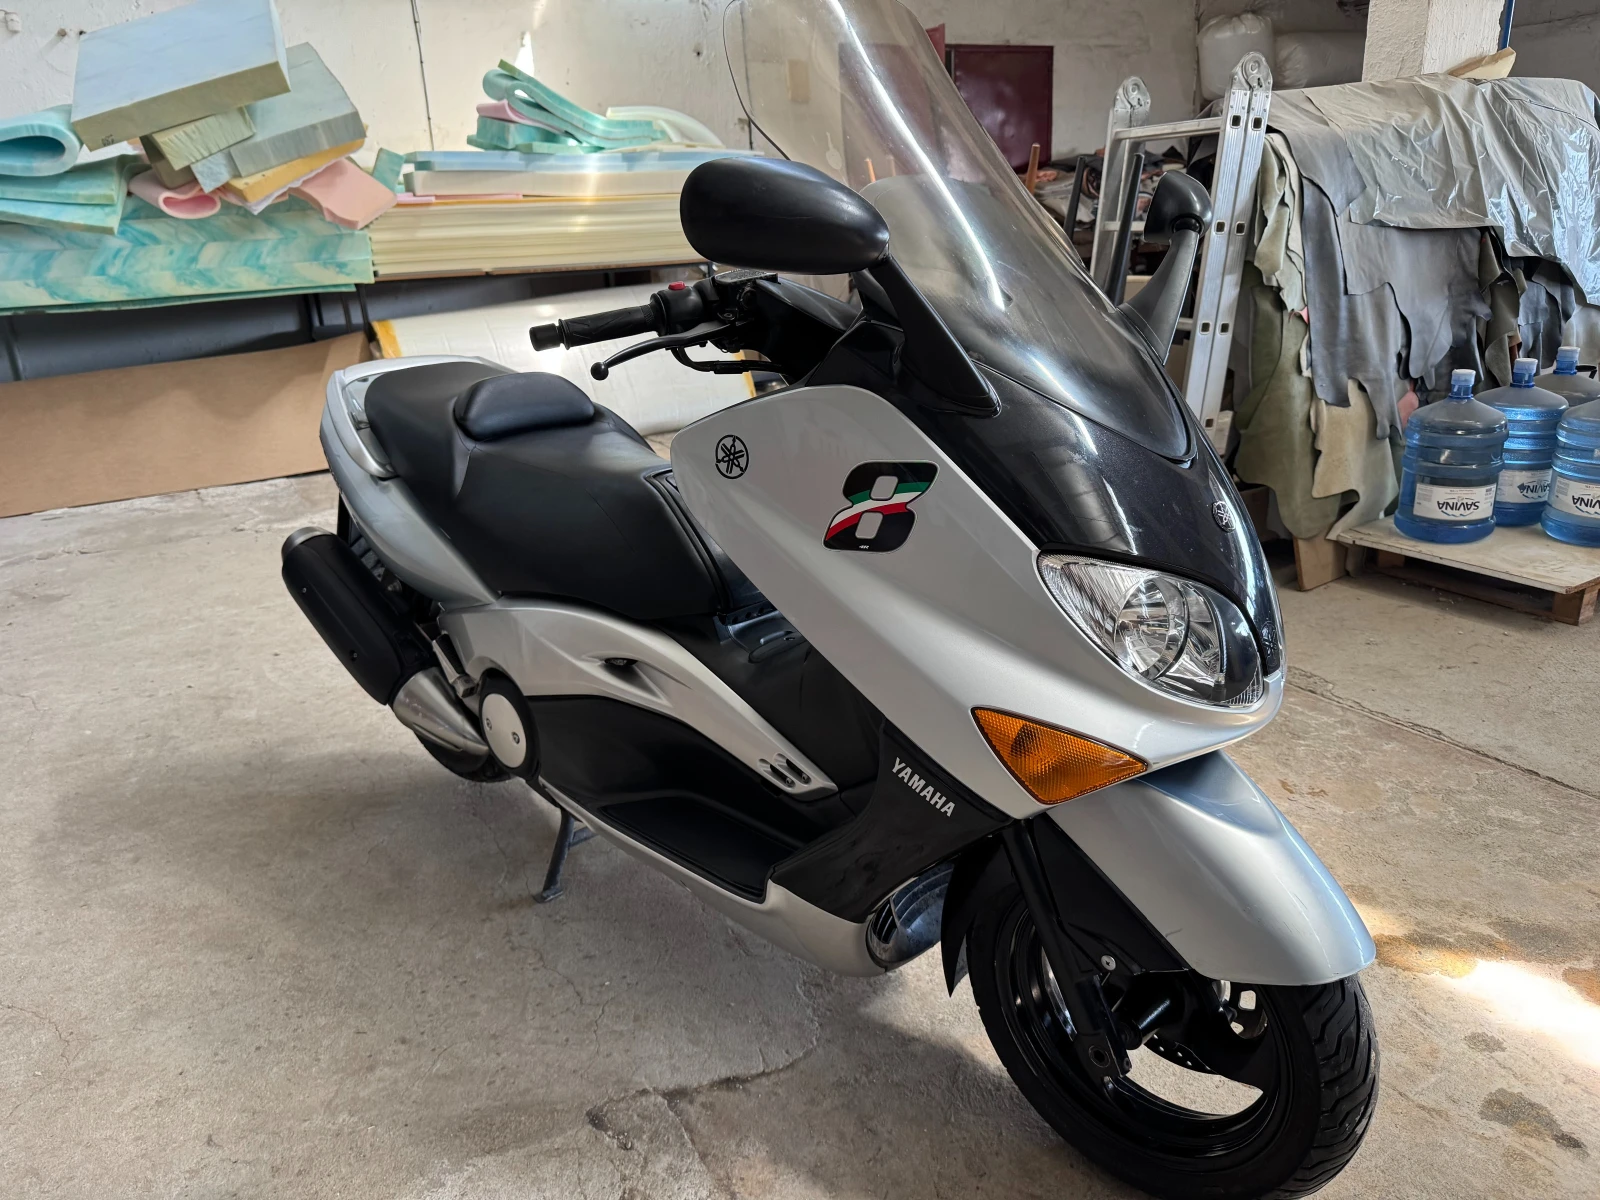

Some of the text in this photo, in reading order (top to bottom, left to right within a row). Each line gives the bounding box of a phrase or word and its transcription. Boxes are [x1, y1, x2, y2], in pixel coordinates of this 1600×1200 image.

[822, 461, 939, 552] 8
[1436, 500, 1480, 511] SAVINA
[892, 756, 956, 817] YAMAHA
